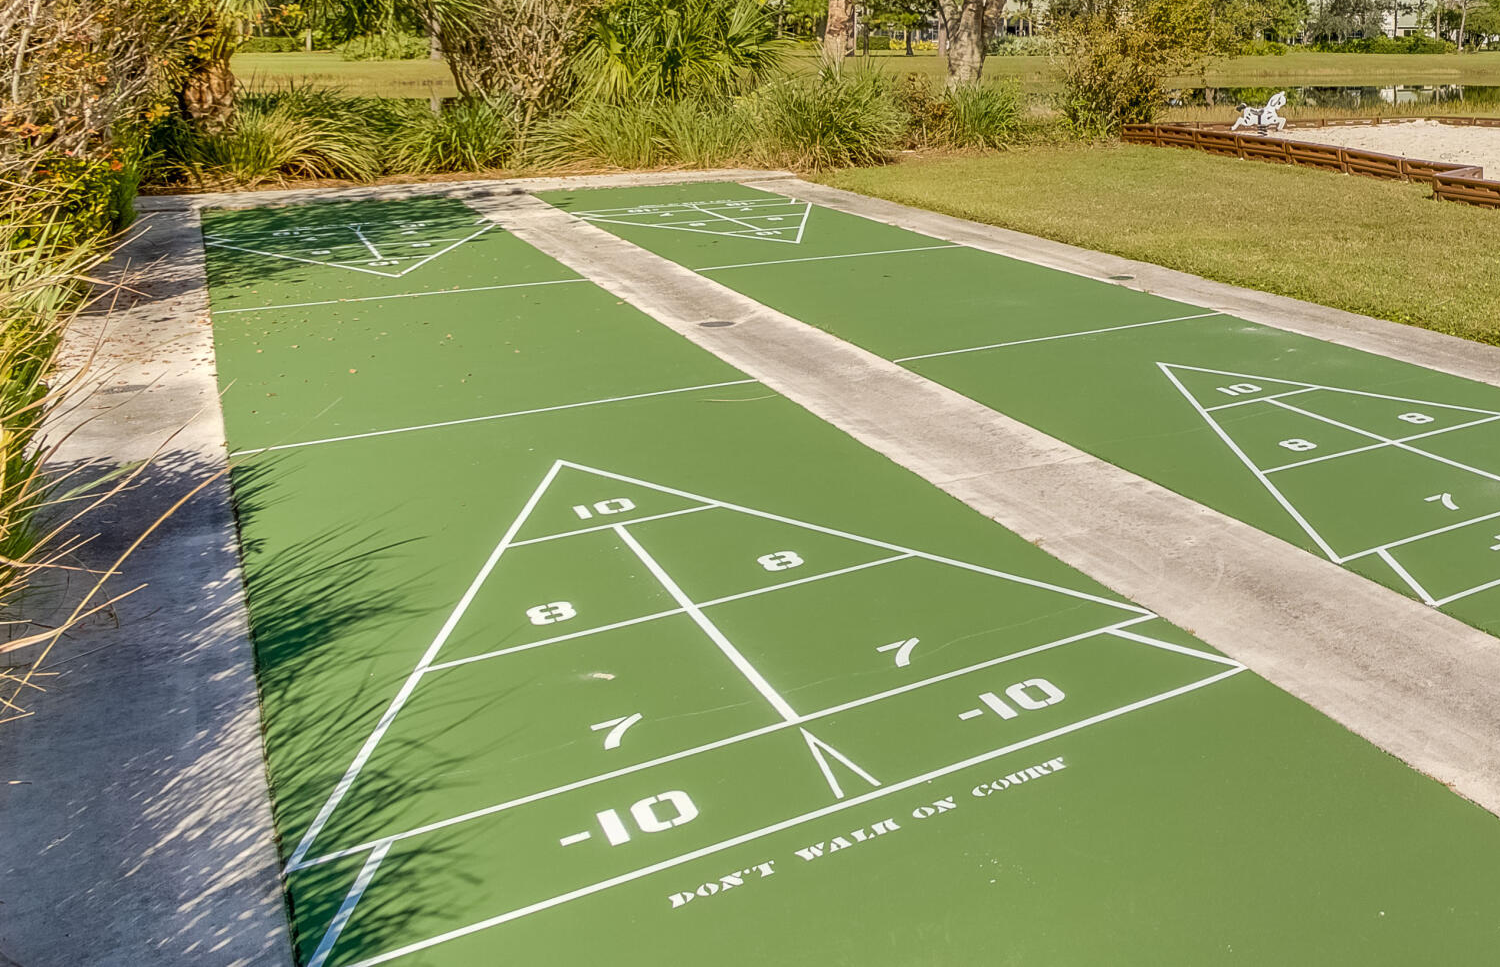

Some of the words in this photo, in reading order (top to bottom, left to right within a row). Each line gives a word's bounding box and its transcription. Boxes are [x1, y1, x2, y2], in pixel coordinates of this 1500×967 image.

[1215, 383, 1263, 397] 10
[1398, 412, 1435, 425] 8
[1279, 438, 1318, 452] 8
[572, 497, 637, 520] 10
[1424, 492, 1460, 511] 7
[757, 550, 806, 572] 8
[526, 601, 578, 626] 8
[875, 637, 921, 668] 7
[957, 678, 1066, 721] -10
[590, 712, 643, 751] 7
[559, 789, 700, 847] -10
[667, 859, 776, 909] DON'T
[794, 817, 901, 862] WALK
[911, 795, 958, 820] ON
[971, 756, 1068, 798] COURT
